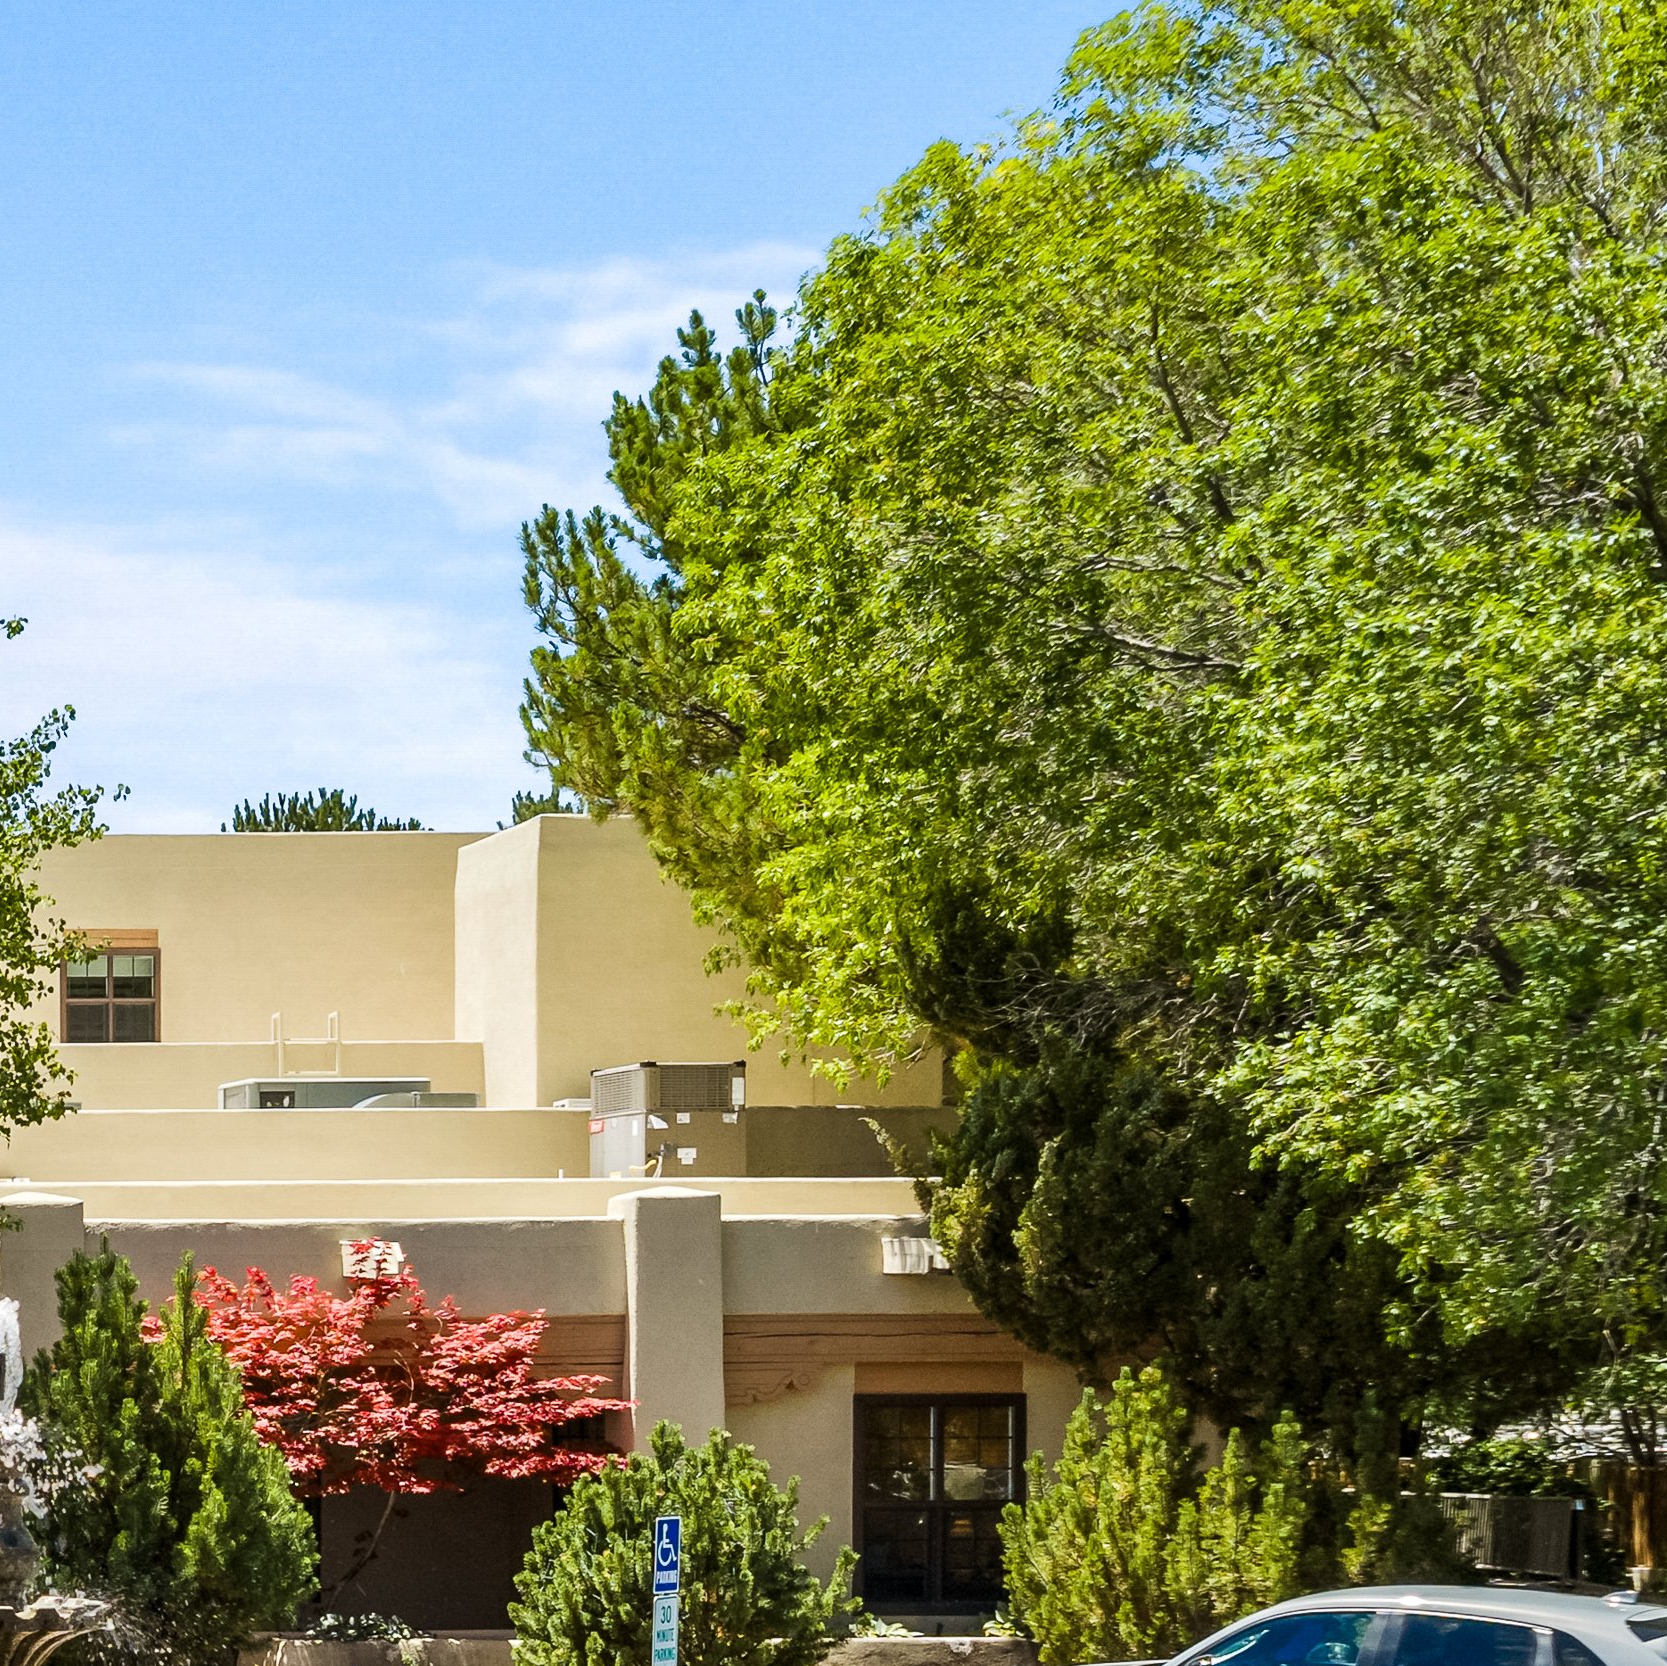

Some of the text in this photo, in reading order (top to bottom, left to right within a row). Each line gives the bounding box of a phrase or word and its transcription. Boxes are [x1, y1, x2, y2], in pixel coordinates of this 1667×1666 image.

[656, 1569, 677, 1584] PARKING
[660, 1605, 672, 1624] 30
[656, 1627, 675, 1643] MINUTE
[654, 1646, 676, 1662] PARKING
